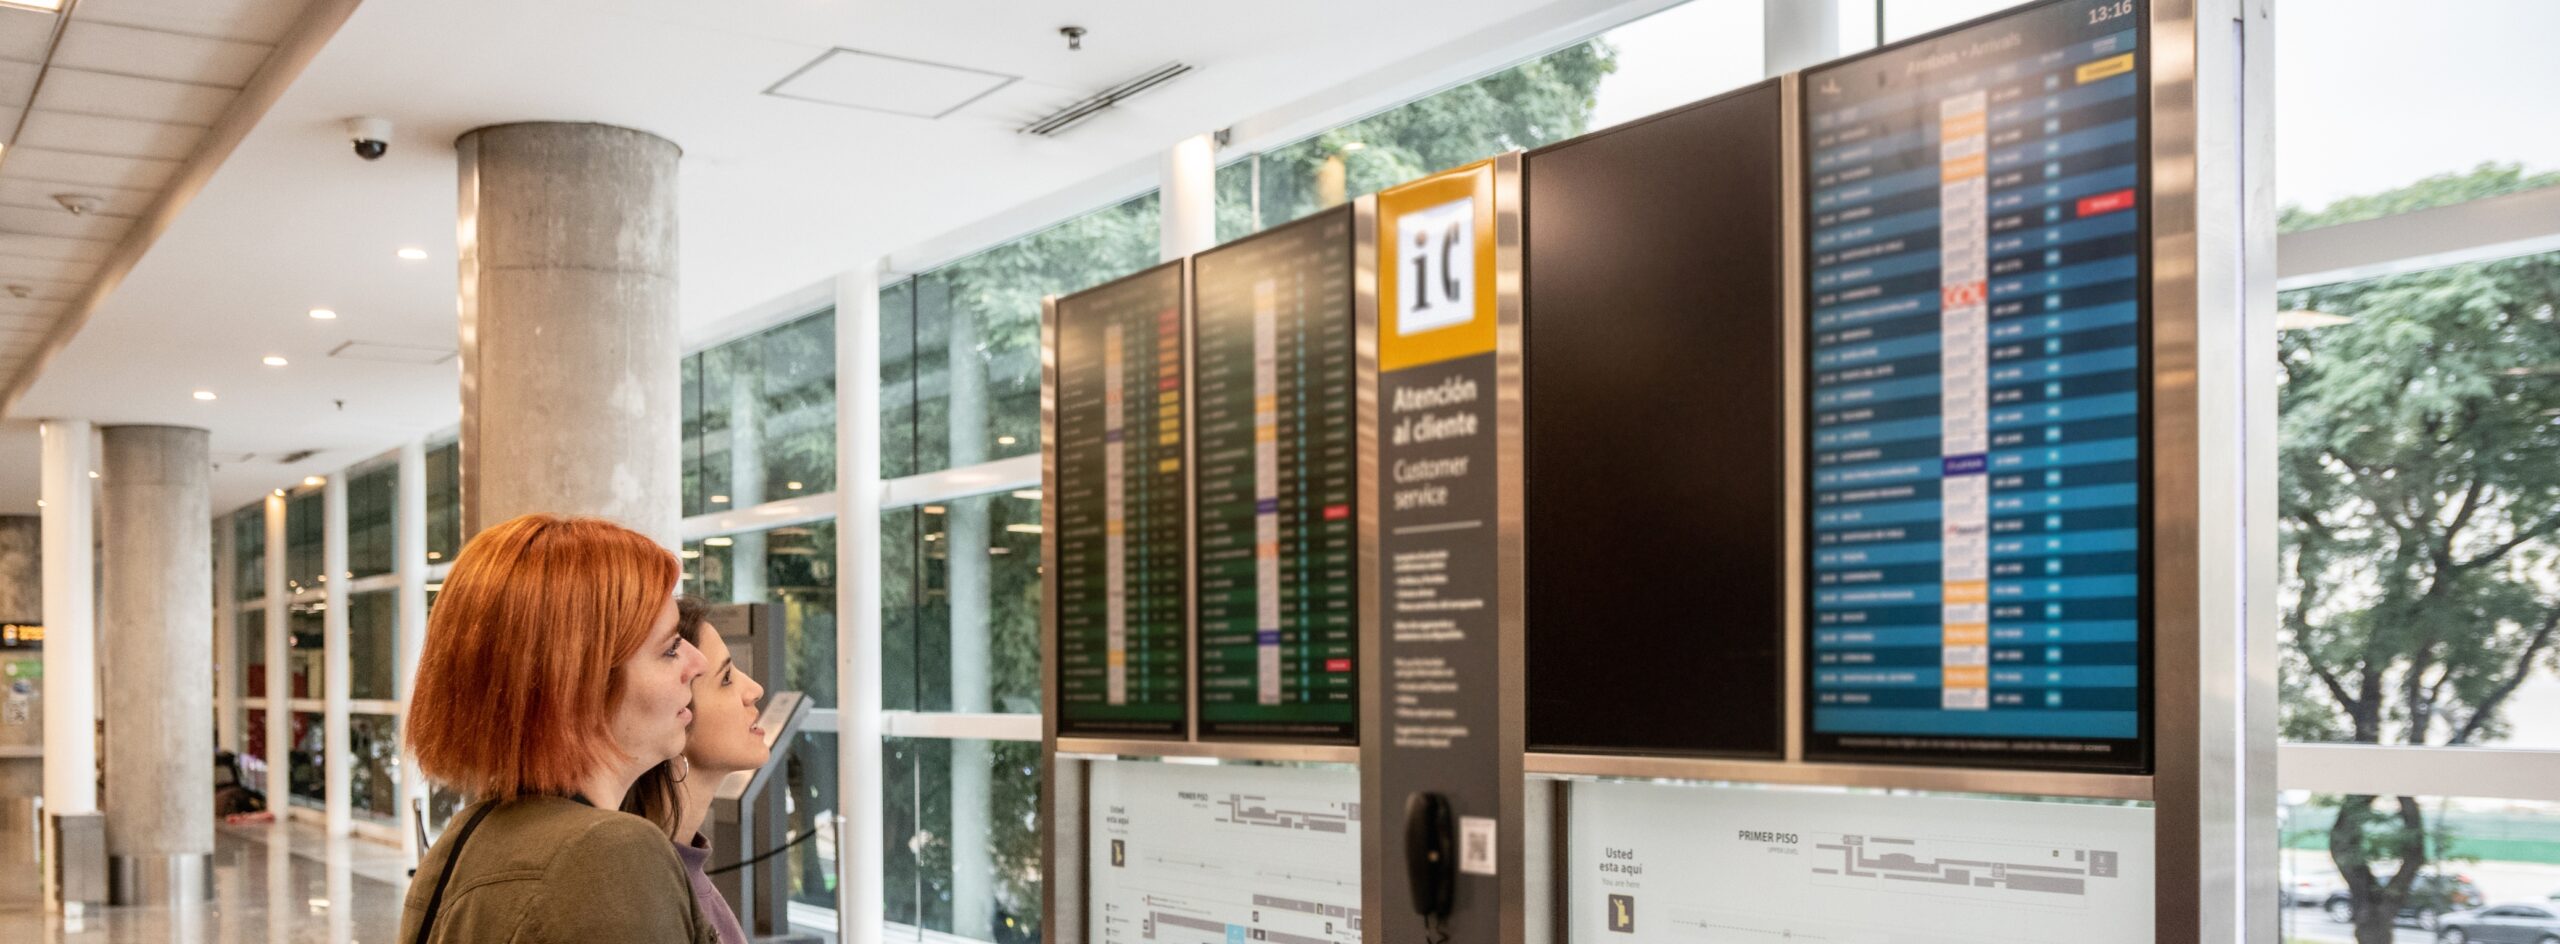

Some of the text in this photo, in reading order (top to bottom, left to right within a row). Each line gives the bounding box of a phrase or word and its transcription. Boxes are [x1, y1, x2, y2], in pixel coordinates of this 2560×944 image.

[2088, 0, 2132, 25] 13:16
[1393, 376, 1478, 413] Atención
[1393, 411, 1479, 446] al cliente
[1393, 456, 1469, 484] Customer
[1393, 483, 1448, 511] service
[1738, 830, 1799, 845] PRIMER PISO
[1605, 847, 1634, 861] Usted
[1599, 862, 1619, 874] esta
